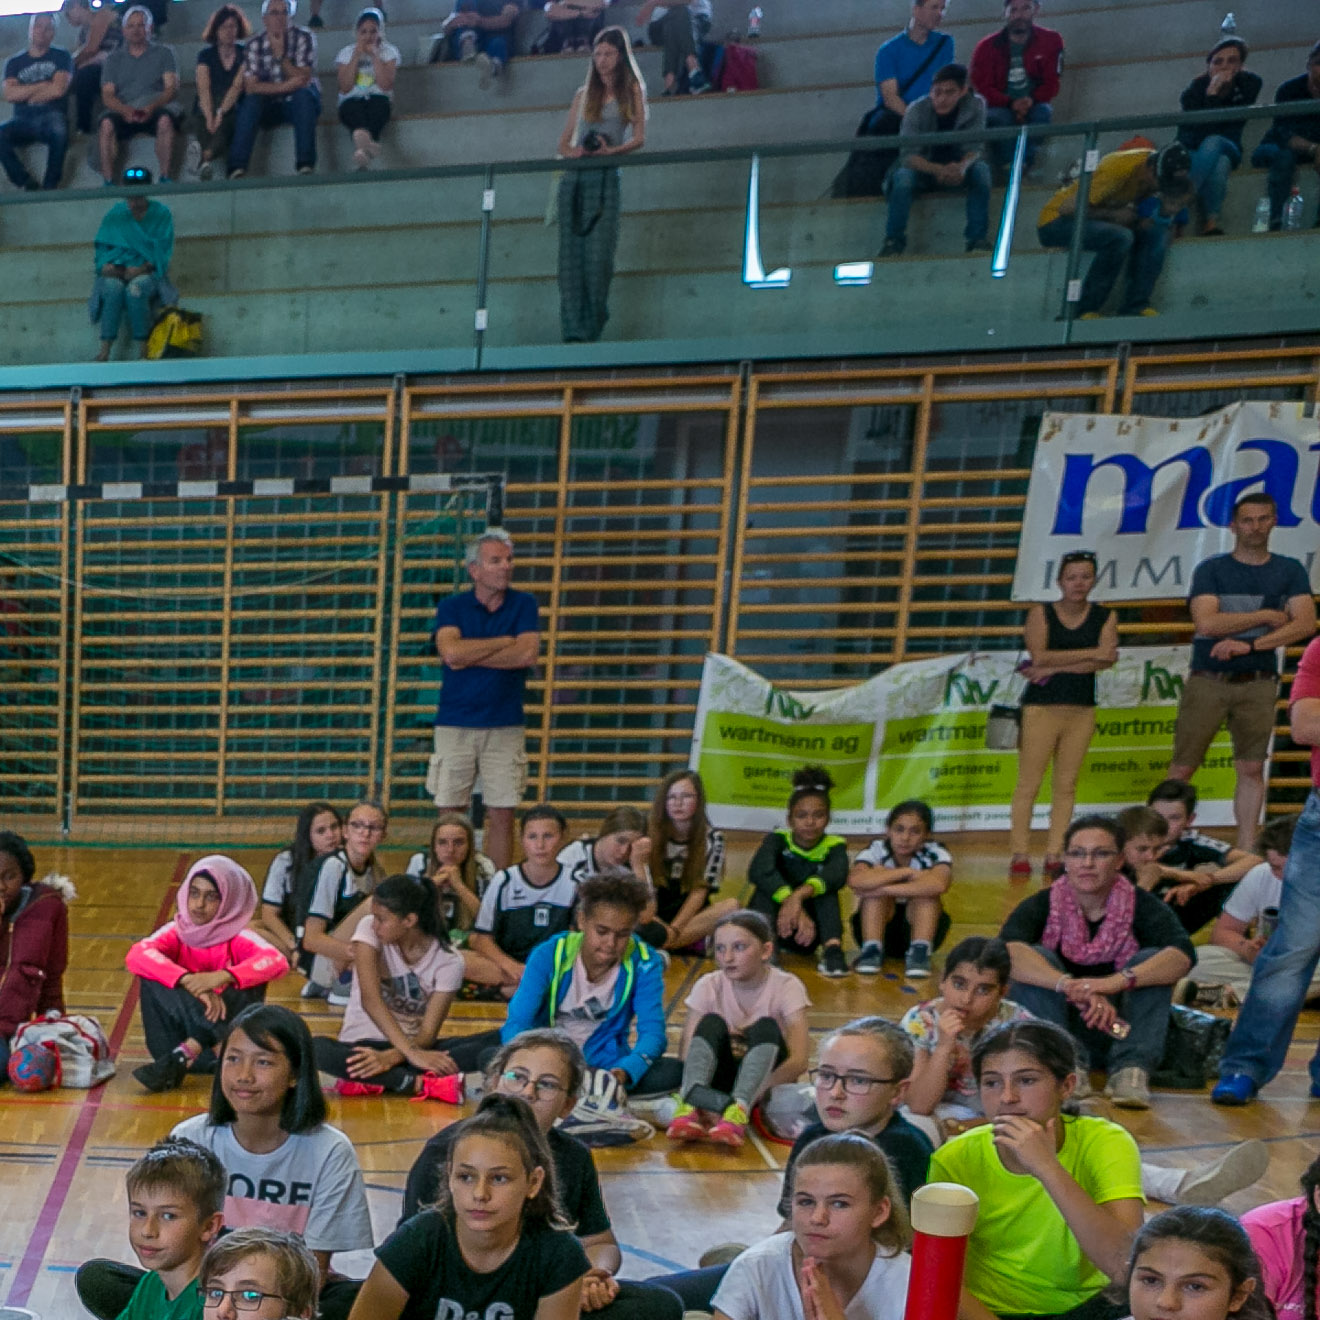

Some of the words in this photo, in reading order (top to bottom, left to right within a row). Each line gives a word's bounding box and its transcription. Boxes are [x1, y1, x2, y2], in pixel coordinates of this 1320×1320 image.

[1050, 437, 1320, 536] ma
[719, 724, 826, 751] wartmann
[831, 734, 860, 754] ag
